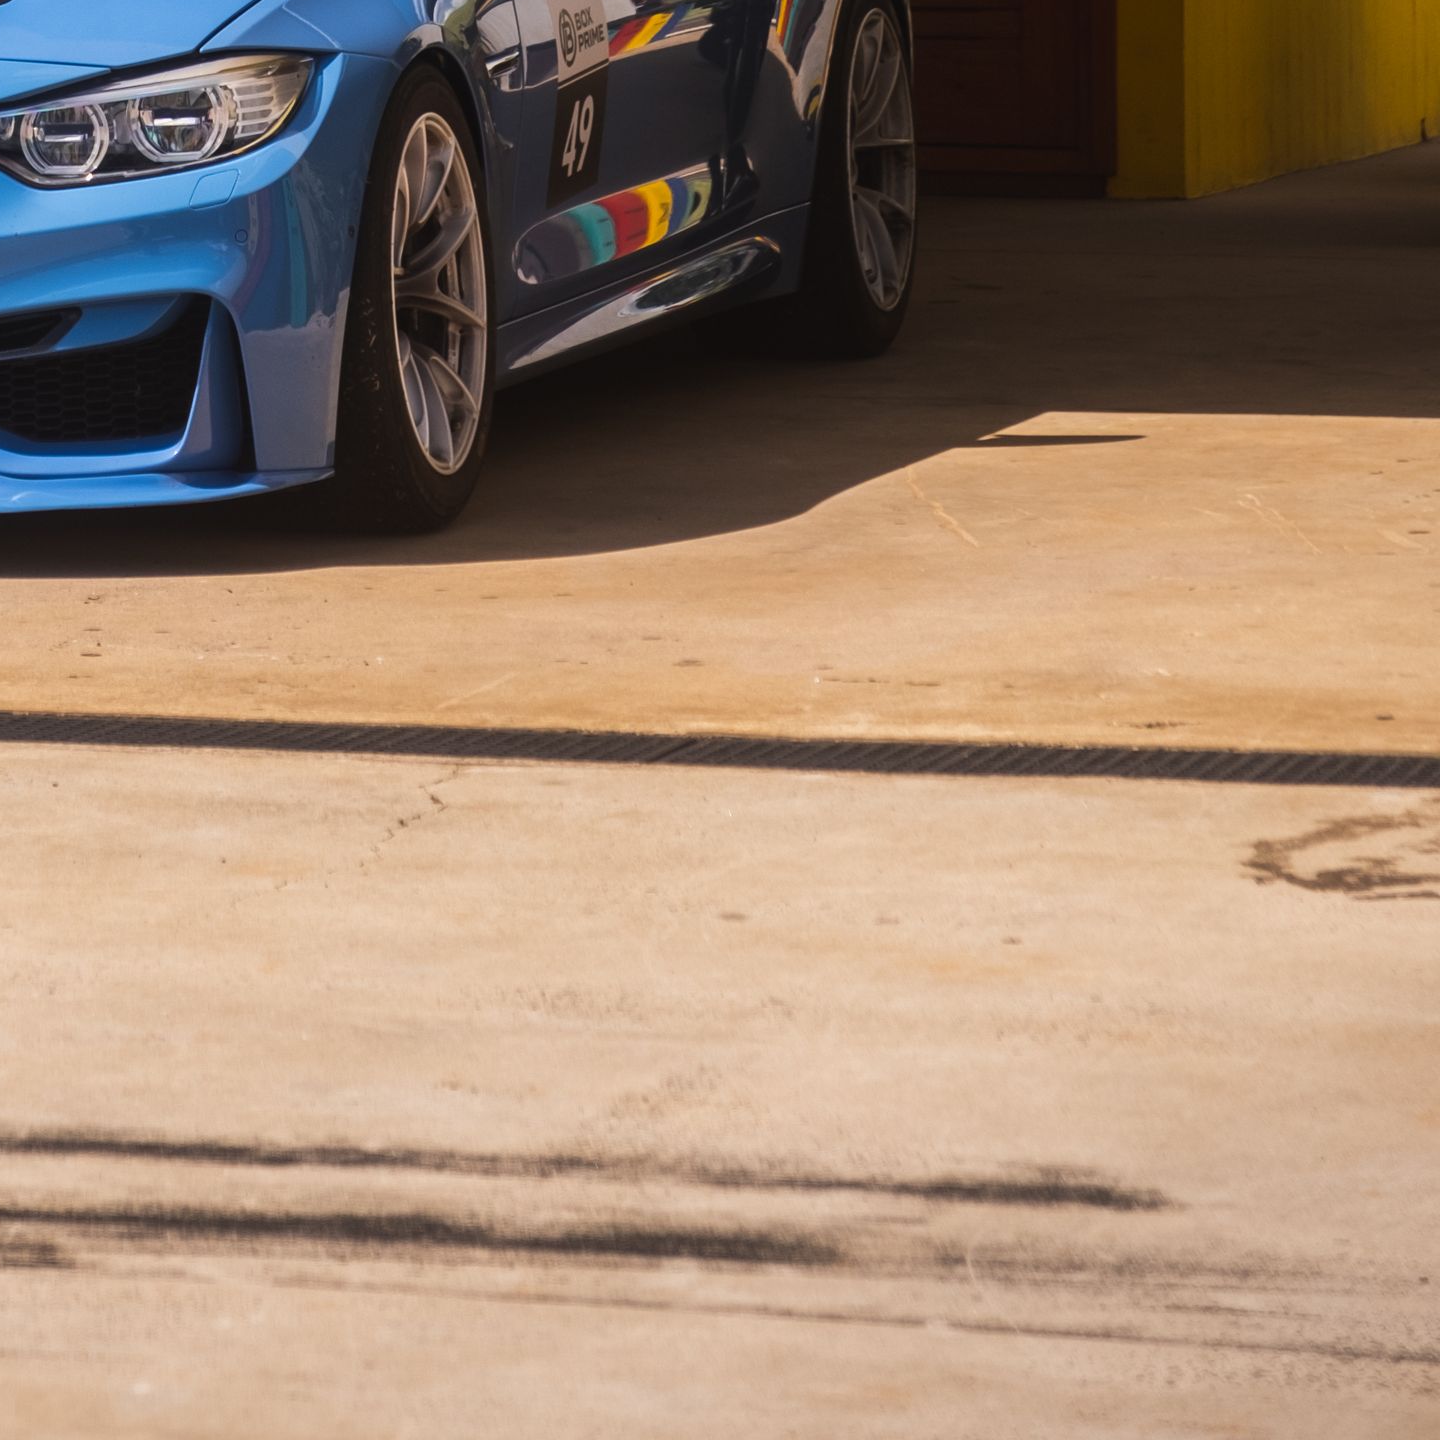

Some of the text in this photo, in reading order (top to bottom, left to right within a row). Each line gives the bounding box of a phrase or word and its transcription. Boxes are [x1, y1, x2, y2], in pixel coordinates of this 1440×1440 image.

[574, 6, 593, 31] BOX
[578, 24, 605, 52] PRIME
[562, 94, 594, 177] 49
